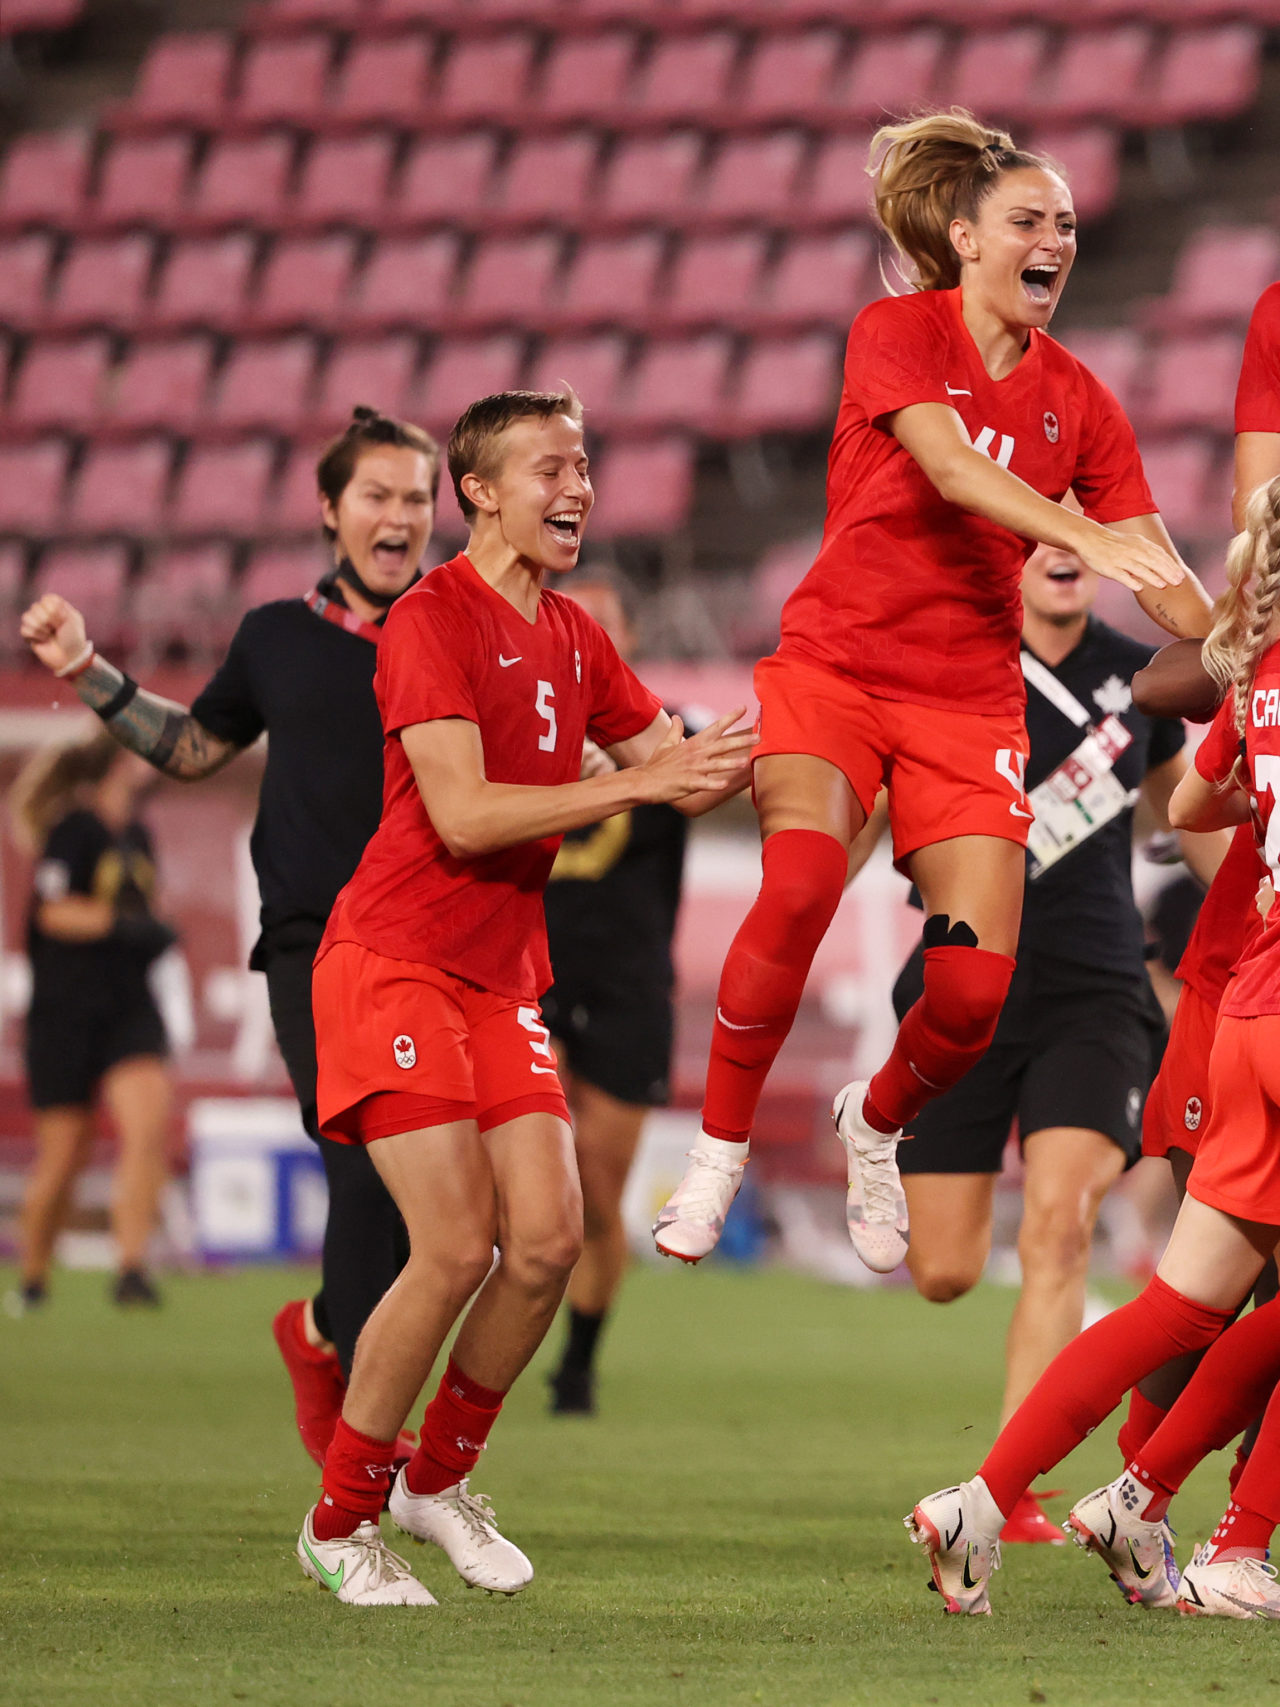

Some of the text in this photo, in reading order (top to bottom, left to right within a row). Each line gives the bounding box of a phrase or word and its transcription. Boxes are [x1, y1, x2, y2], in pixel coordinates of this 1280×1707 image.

[535, 679, 557, 752] 5
[994, 748, 1025, 805] 4
[517, 1006, 552, 1060] 5
